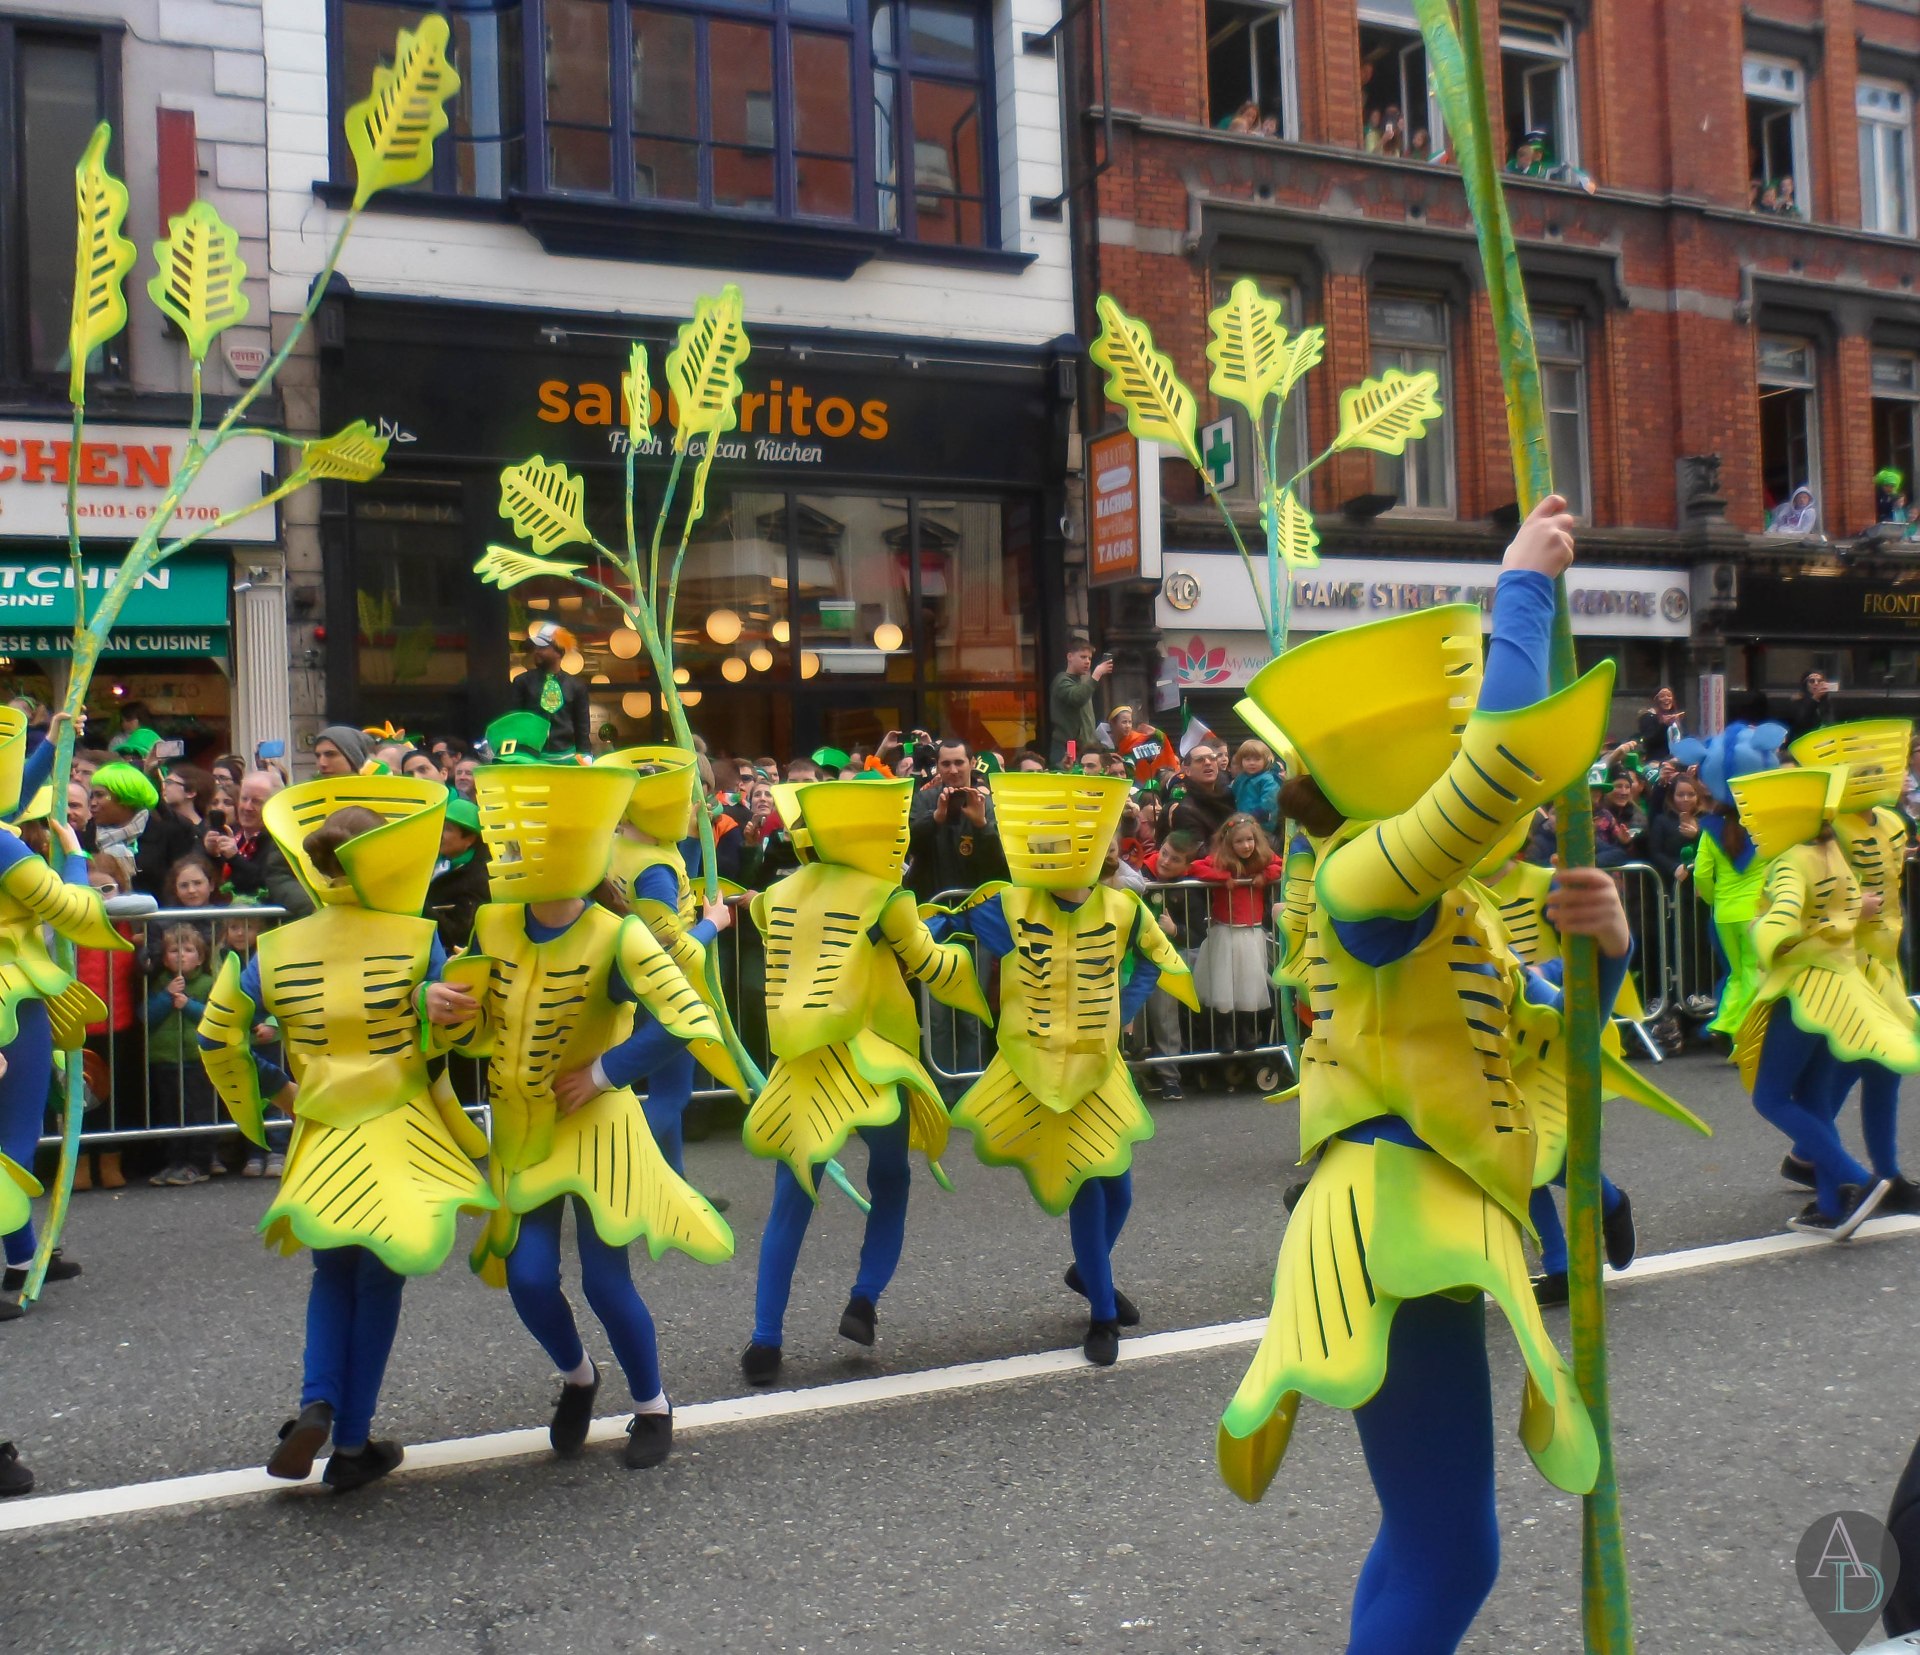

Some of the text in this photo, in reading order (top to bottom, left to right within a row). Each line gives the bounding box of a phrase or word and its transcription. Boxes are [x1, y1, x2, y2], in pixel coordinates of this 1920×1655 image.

[537, 371, 888, 440] sabritos
[670, 435, 747, 460] excan
[755, 439, 823, 463] Kitchen
[1097, 538, 1133, 564] TACOS
[1295, 581, 1364, 608] DAME
[1369, 583, 1462, 608] STREET
[37, 635, 51, 650] &
[56, 635, 131, 650] INAN
[136, 635, 211, 650] CUISINE
